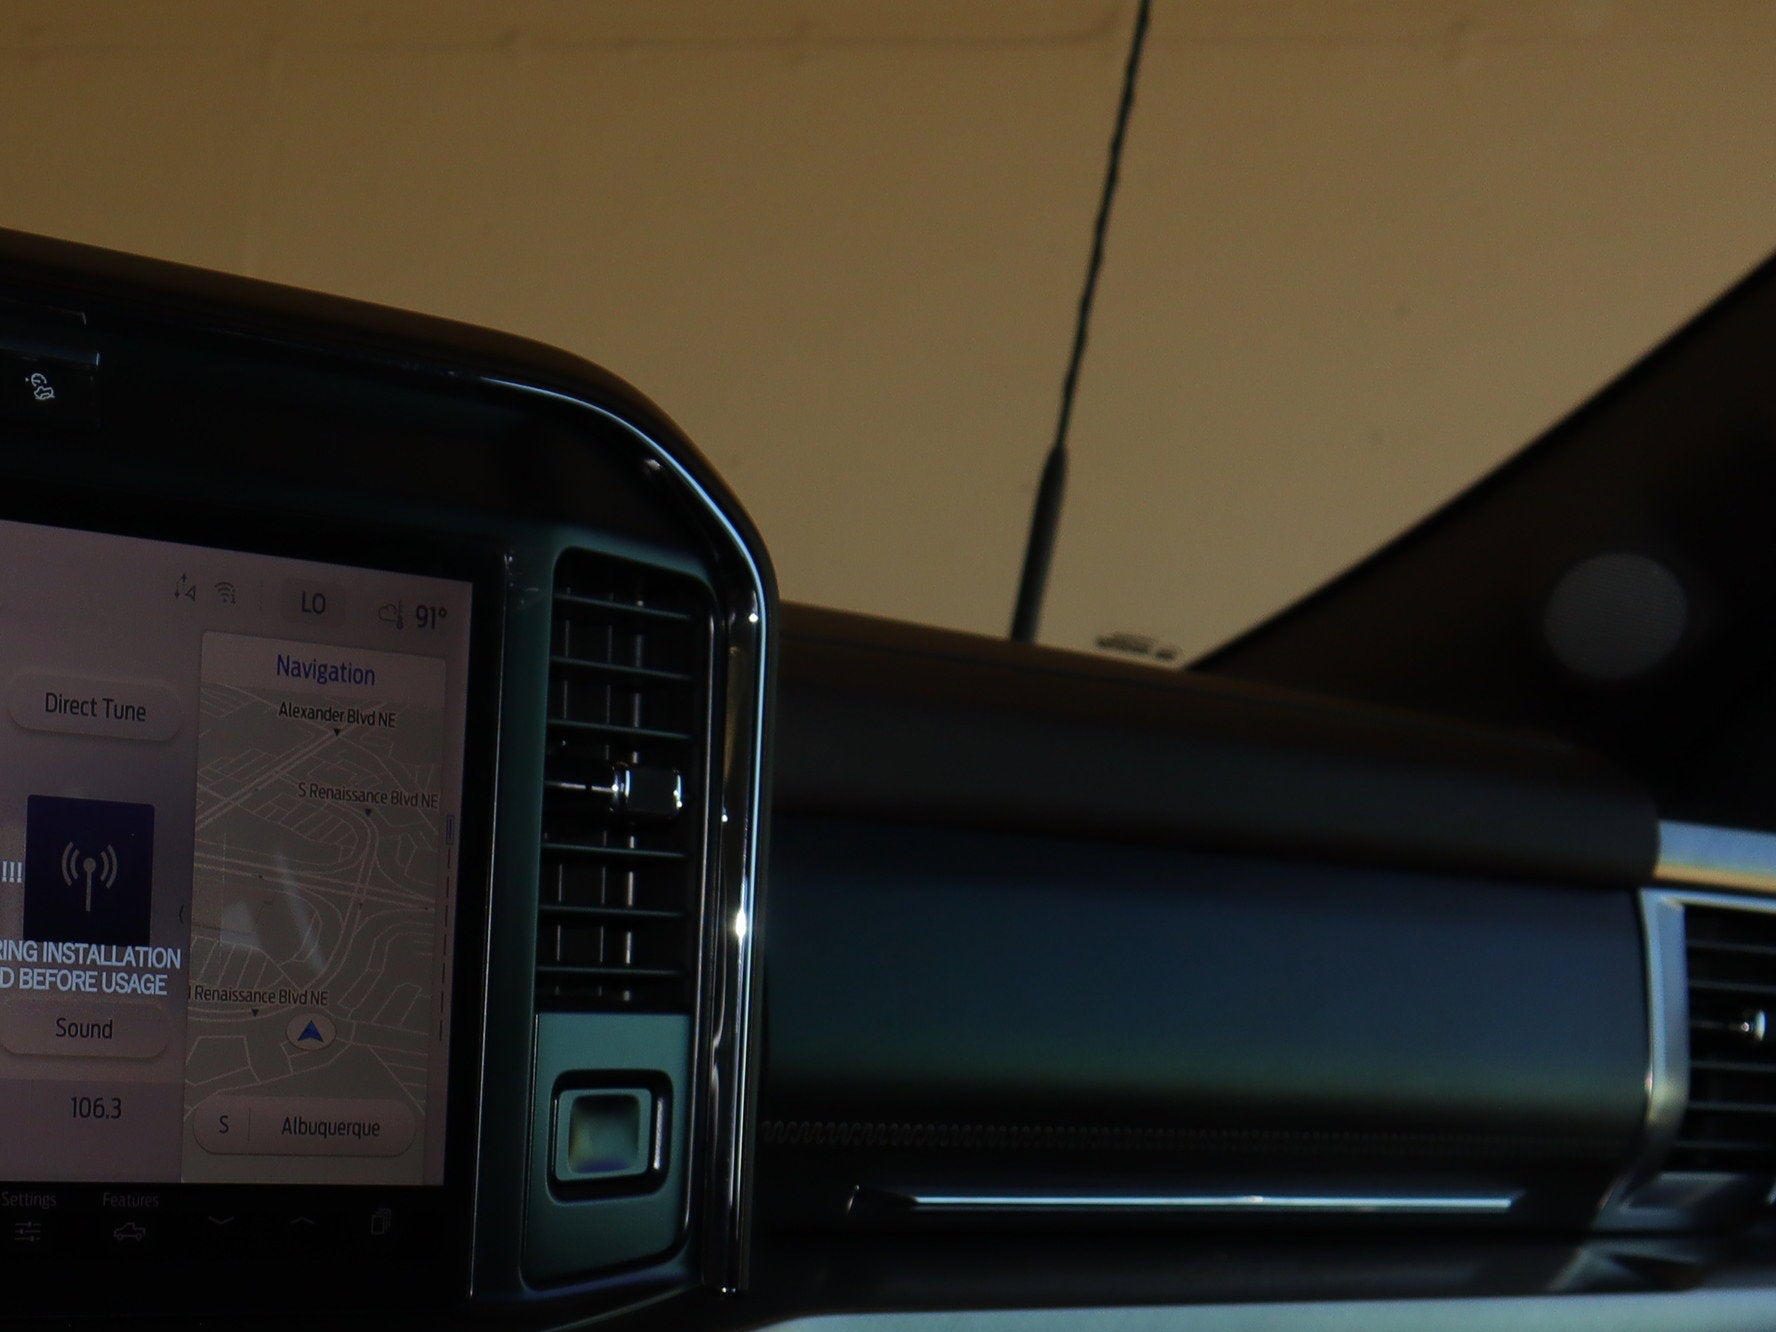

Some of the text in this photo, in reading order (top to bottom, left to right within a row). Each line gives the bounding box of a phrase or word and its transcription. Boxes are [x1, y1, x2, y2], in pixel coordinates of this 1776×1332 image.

[301, 591, 326, 615] LO
[277, 654, 376, 686] Navigation
[45, 693, 146, 722] Direct Tune
[279, 701, 396, 728] Alexander Blvd NE
[298, 783, 438, 809] S Renaissance Blvd NE
[43, 940, 181, 969] INSTALLATION
[19, 967, 98, 992] BEFORE
[102, 971, 168, 996] USAGE
[195, 984, 276, 1004] Renaissance
[279, 989, 307, 1005] Blvd
[311, 990, 328, 1006] NE
[56, 1017, 113, 1040] Sound
[71, 1097, 122, 1120] 106.3
[219, 1115, 229, 1134] S
[282, 1116, 380, 1139] Albuquerque
[1, 1191, 57, 1209] Settings
[102, 1192, 160, 1208] Features
